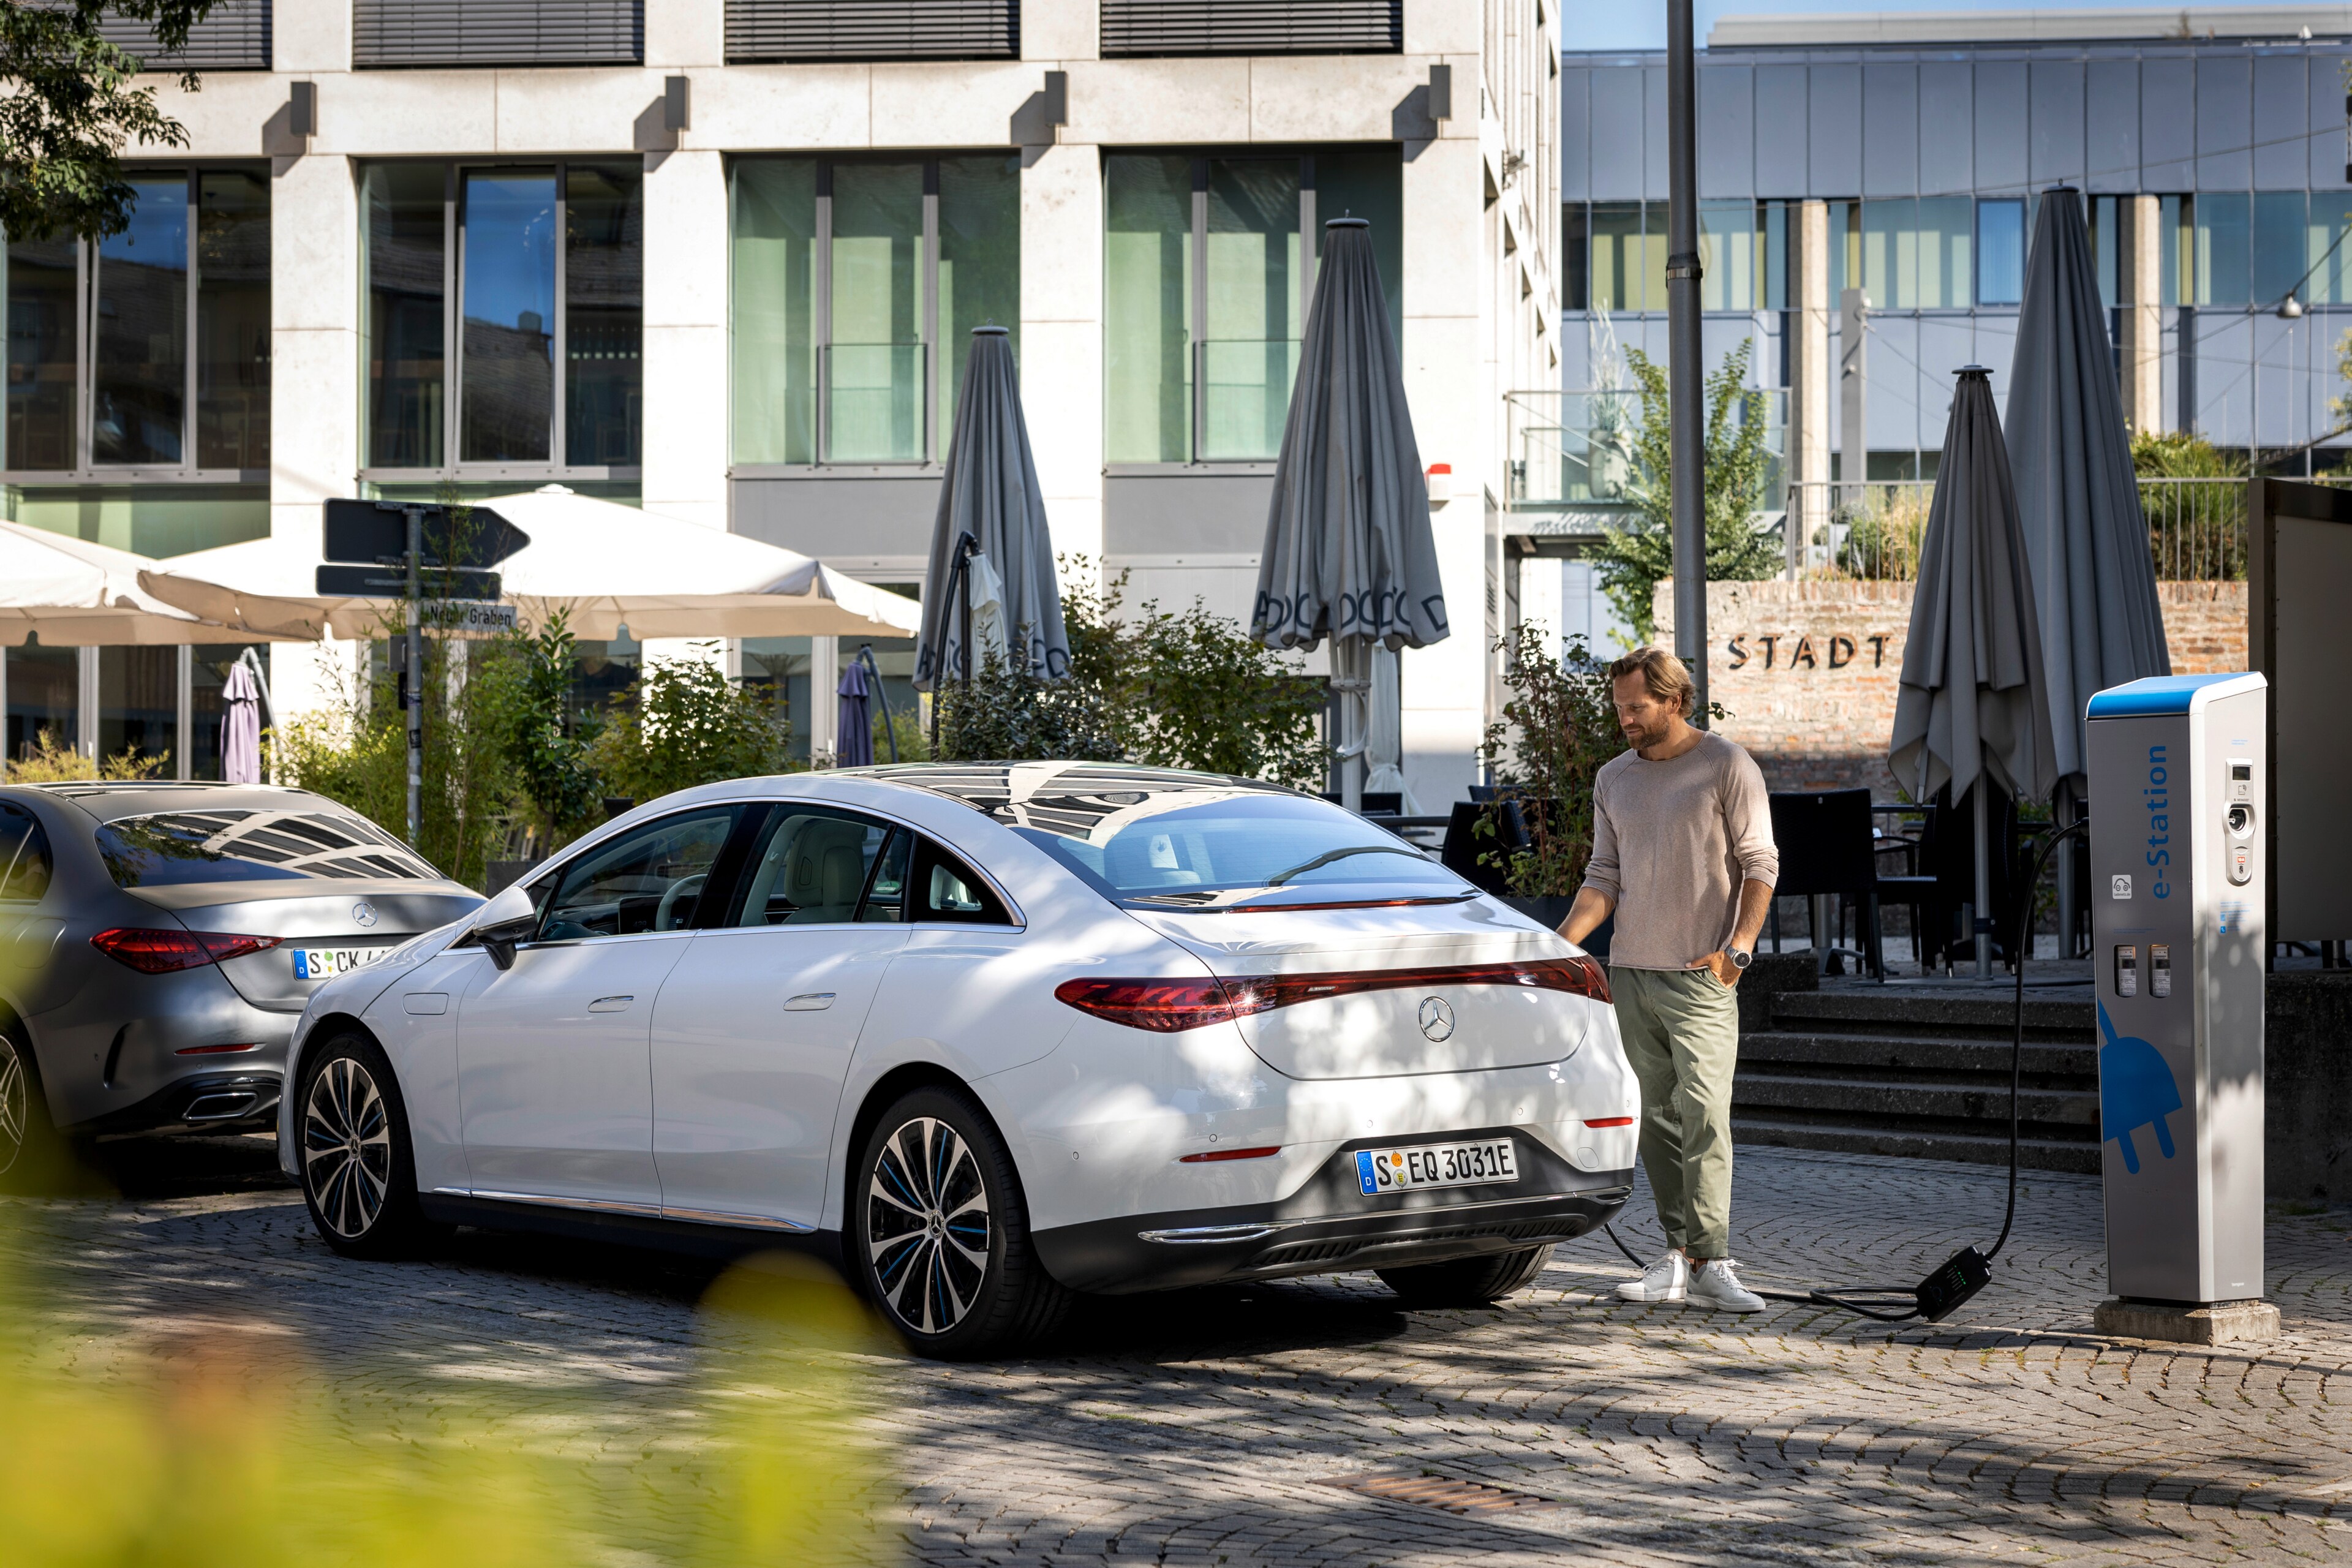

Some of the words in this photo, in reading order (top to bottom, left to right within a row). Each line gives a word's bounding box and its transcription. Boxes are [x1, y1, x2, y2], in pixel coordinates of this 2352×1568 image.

[430, 606, 464, 623] Neur
[470, 608, 511, 626] Graben
[1729, 632, 1893, 669] STADT
[2144, 745, 2171, 899] e-Station
[309, 953, 321, 974] S
[1375, 1156, 1392, 1186] S
[1407, 1152, 1439, 1183] EQ
[1442, 1144, 1514, 1180] 3031E
[1365, 1177, 1372, 1186] D
